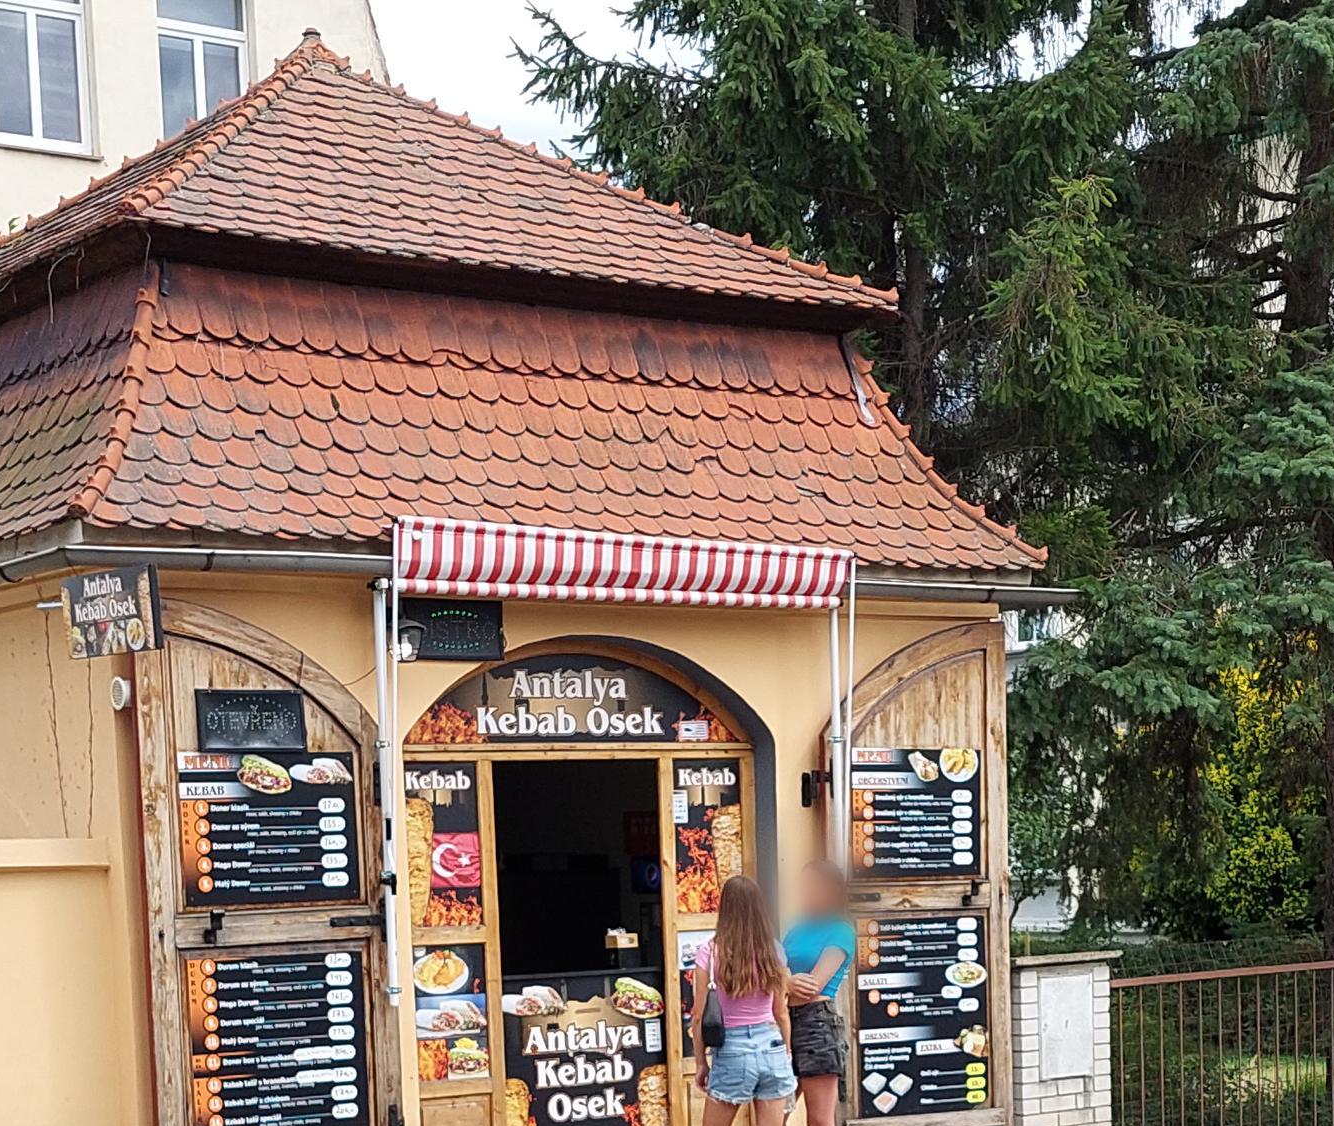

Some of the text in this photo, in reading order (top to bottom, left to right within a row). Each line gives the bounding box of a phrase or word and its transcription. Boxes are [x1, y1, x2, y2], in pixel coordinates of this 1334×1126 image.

[82, 573, 123, 598] Antalya
[74, 595, 138, 623] Kebab Osek
[509, 669, 627, 705] Antalya
[207, 704, 297, 731] OTEVŘENO
[476, 705, 665, 736] Kebab Osek
[186, 785, 225, 796] KEBAB
[404, 769, 471, 791] Kebab
[677, 766, 737, 787] Kebab
[523, 1019, 641, 1055] Antalya
[535, 1053, 634, 1089] Kebab
[547, 1088, 626, 1123] Osek
